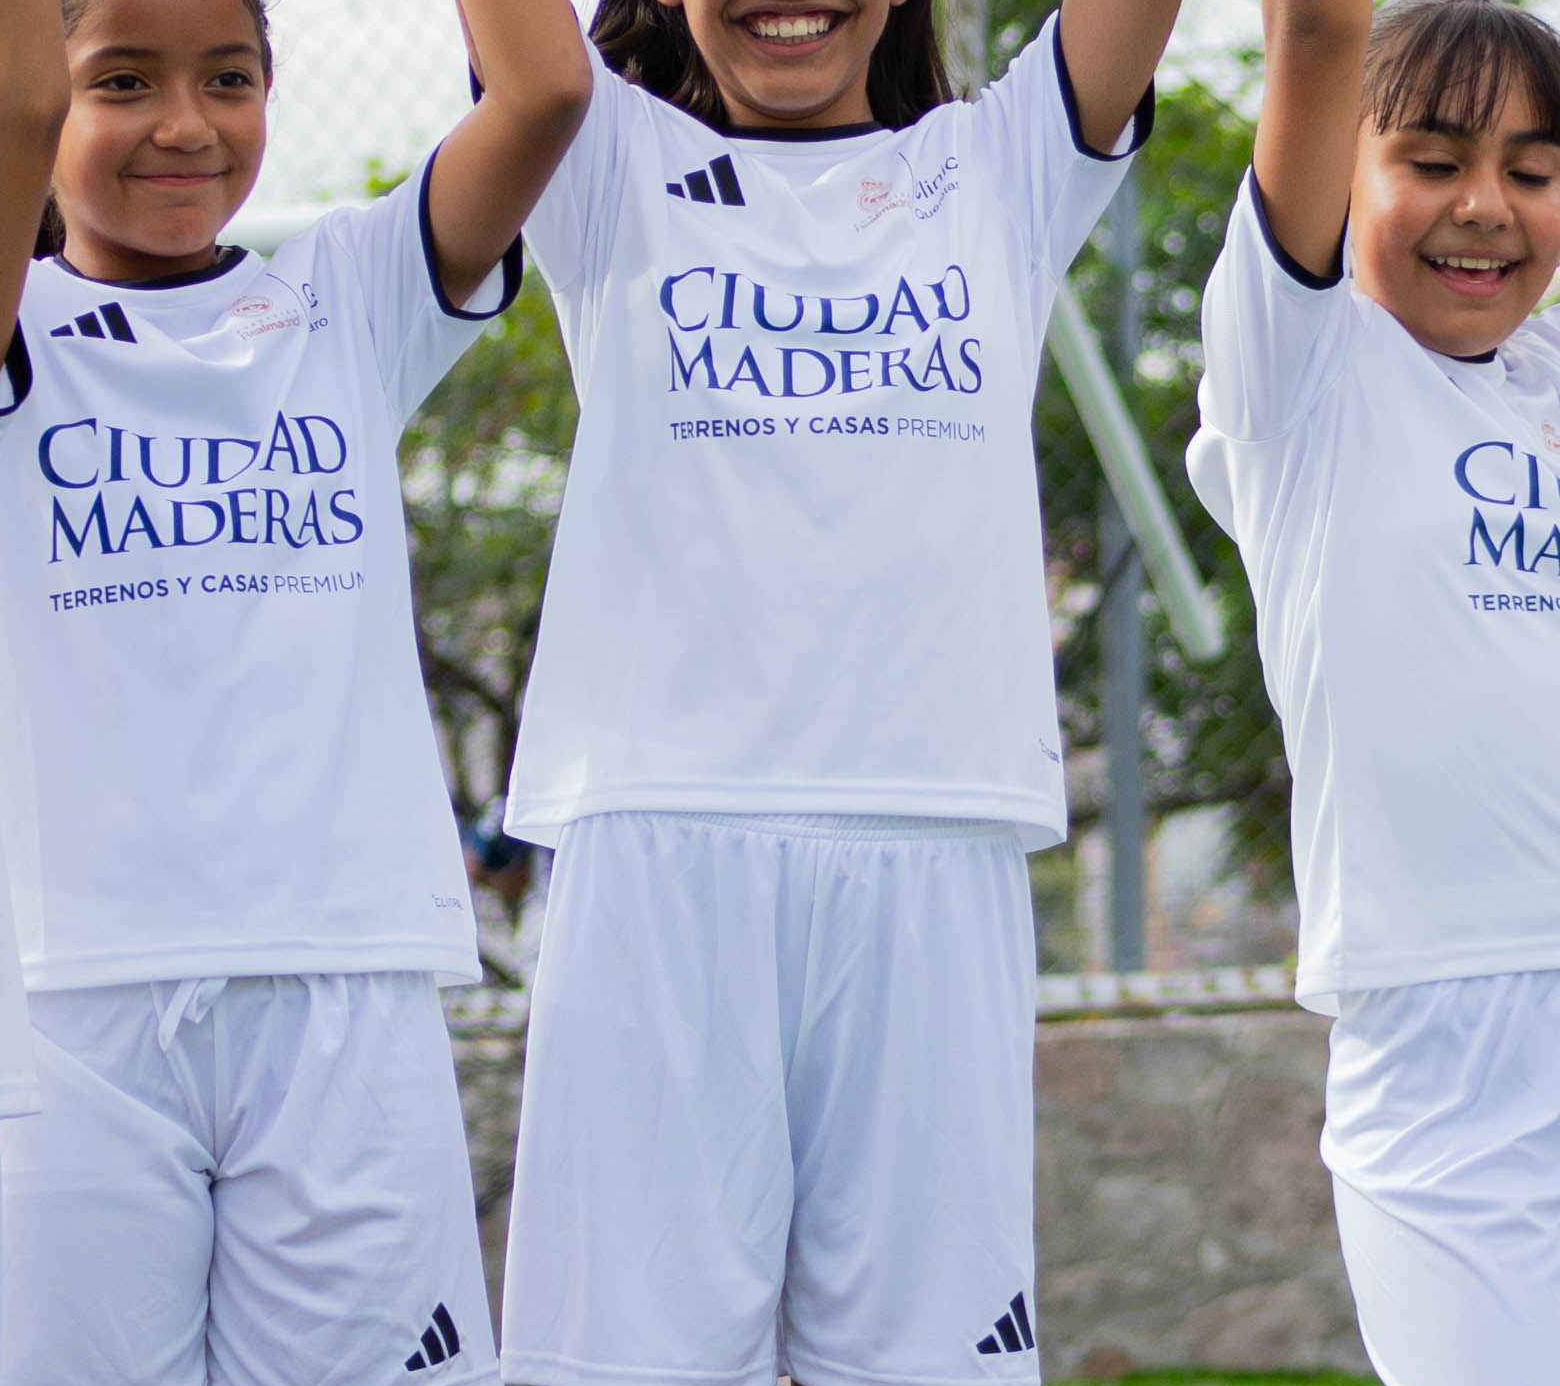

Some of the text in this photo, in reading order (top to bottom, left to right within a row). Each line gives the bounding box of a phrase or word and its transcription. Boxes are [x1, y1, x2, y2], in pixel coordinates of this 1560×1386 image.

[659, 264, 971, 335] CIUDAD
[667, 325, 982, 398] MADERAS
[38, 409, 348, 490] CIUDAD
[670, 415, 986, 444] TERRENOS Y CASAS PREMIUM
[47, 487, 365, 565] MADERAS
[49, 577, 170, 613] TERRENOS
[176, 575, 193, 595] Y
[201, 573, 270, 594] CASAS
